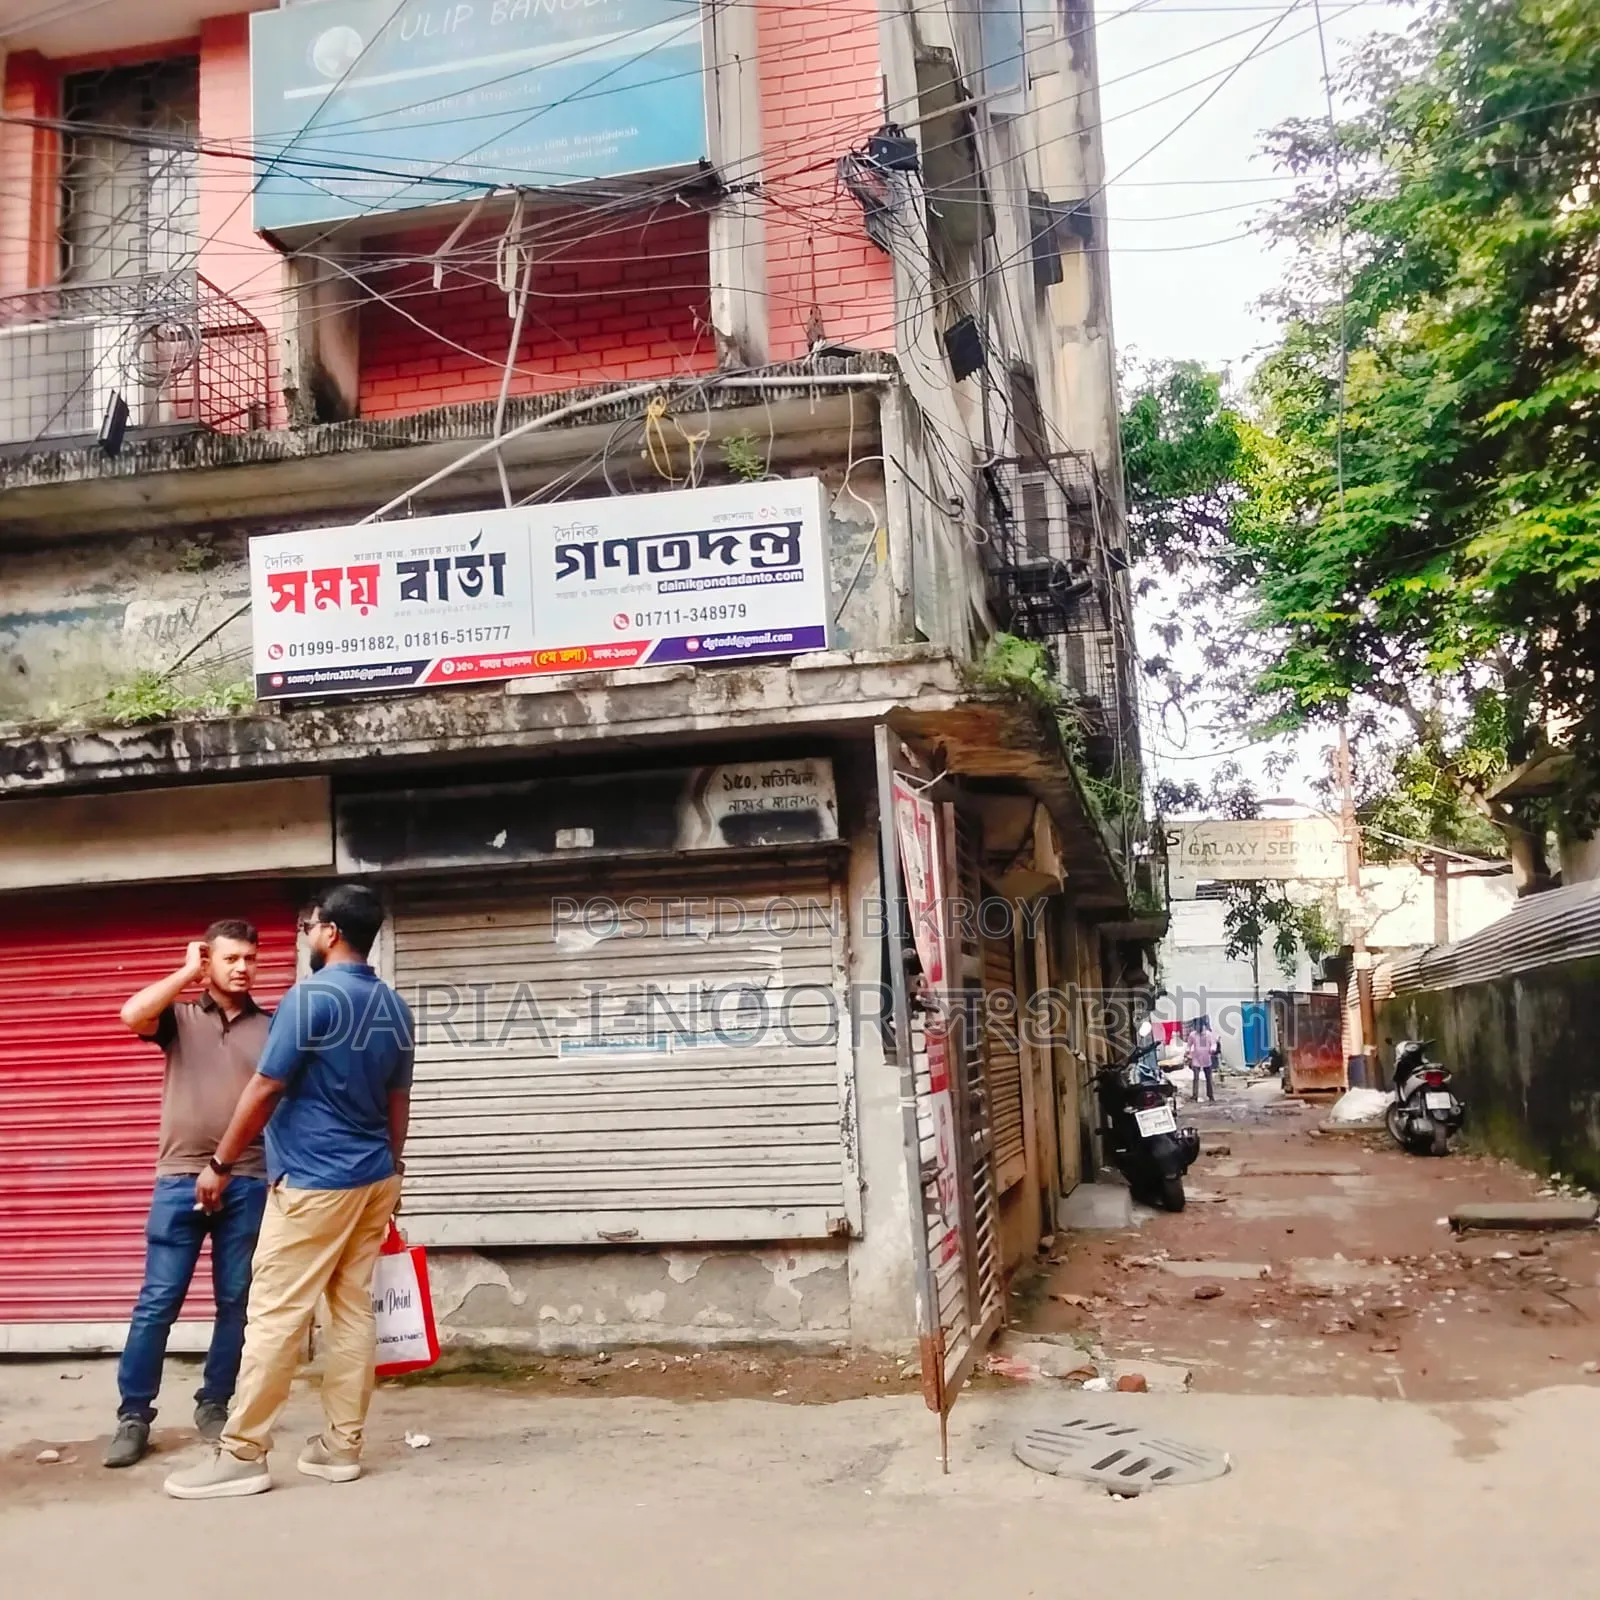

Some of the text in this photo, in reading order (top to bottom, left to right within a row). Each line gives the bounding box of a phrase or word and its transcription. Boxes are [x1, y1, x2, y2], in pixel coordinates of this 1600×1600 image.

[757, 505, 778, 519] ৩২
[553, 521, 600, 542] দৈনিক
[263, 552, 304, 570] দৈনিক
[555, 521, 804, 581] গণতদন্ত
[267, 528, 506, 617] সময় বার্তা
[658, 569, 804, 594] dainikgonotadanto.com
[635, 603, 747, 628] 01711-348979
[289, 625, 511, 658] 01999-991882, 01816-515777
[1188, 840, 1263, 857] GALAXY
